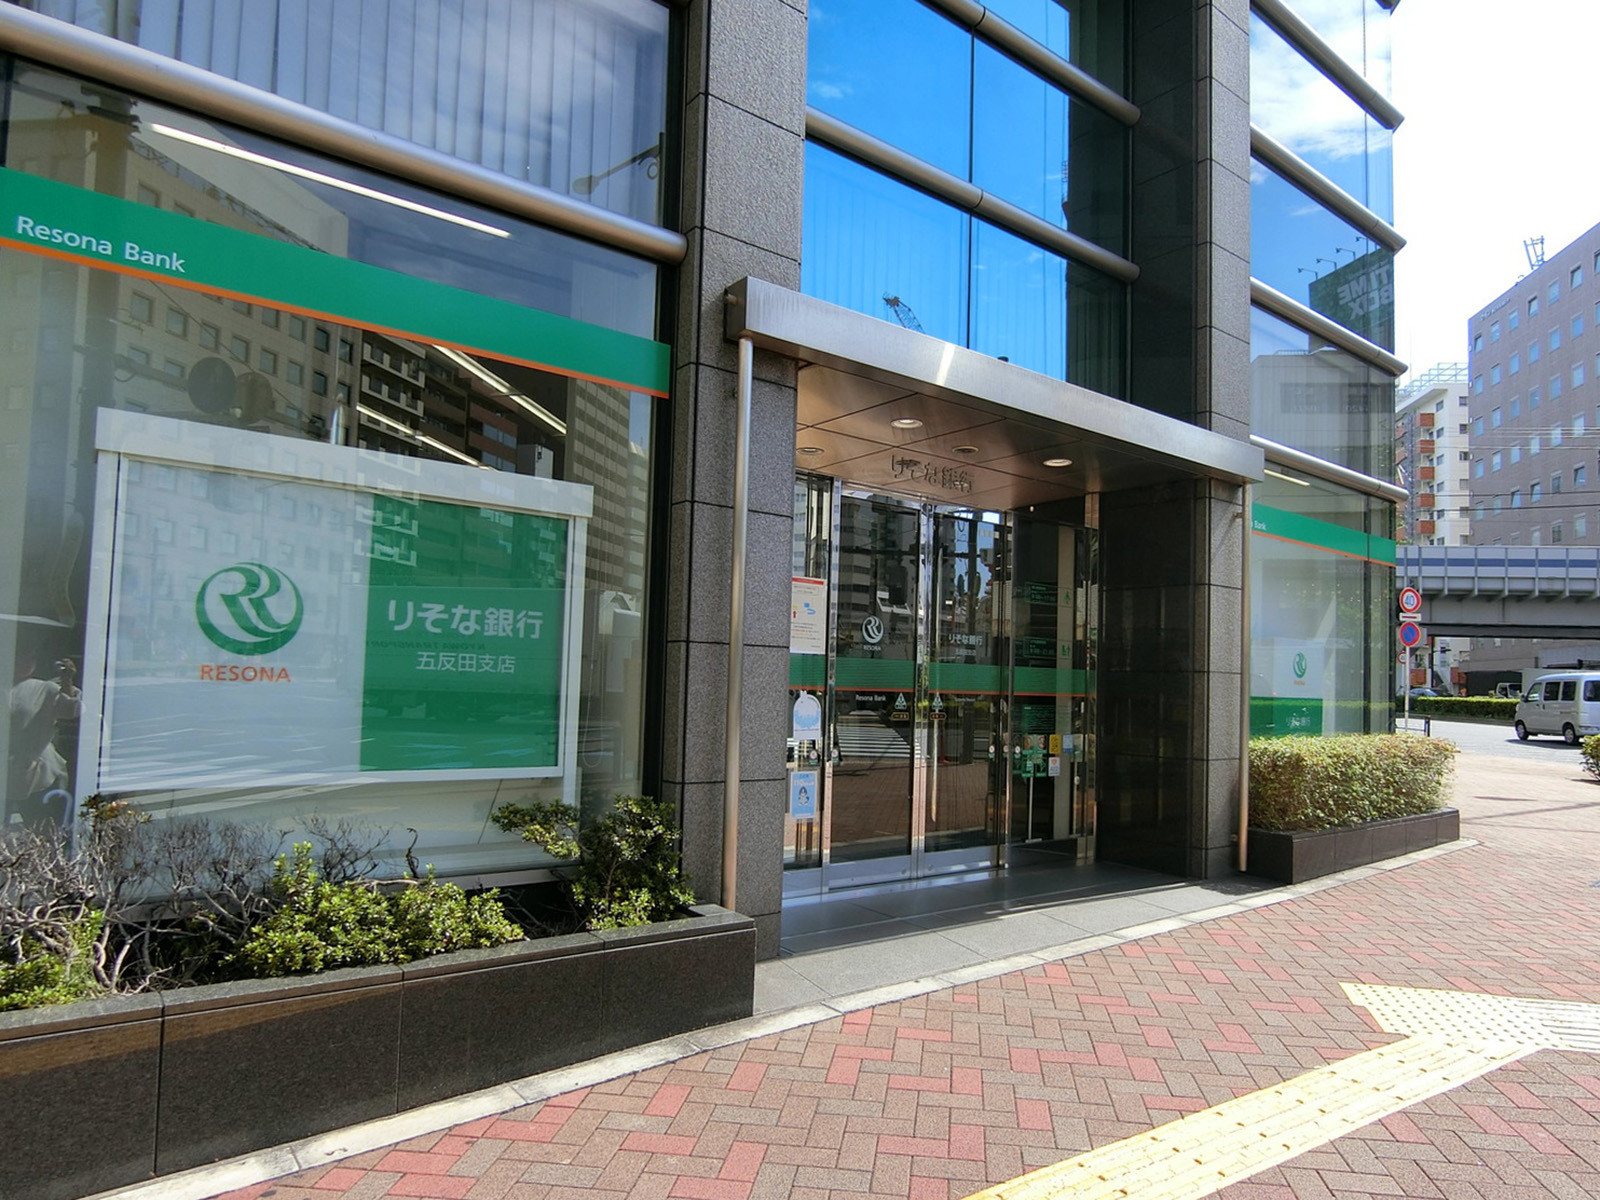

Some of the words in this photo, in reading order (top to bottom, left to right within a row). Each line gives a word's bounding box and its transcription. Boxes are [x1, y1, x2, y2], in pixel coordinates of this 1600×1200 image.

[15, 215, 112, 256] Resona
[123, 241, 186, 274] Bank
[1405, 595, 1415, 606] 40
[387, 599, 544, 639] りそな銀行
[200, 664, 291, 683] RESONA
[415, 651, 516, 674] 五反田支店
